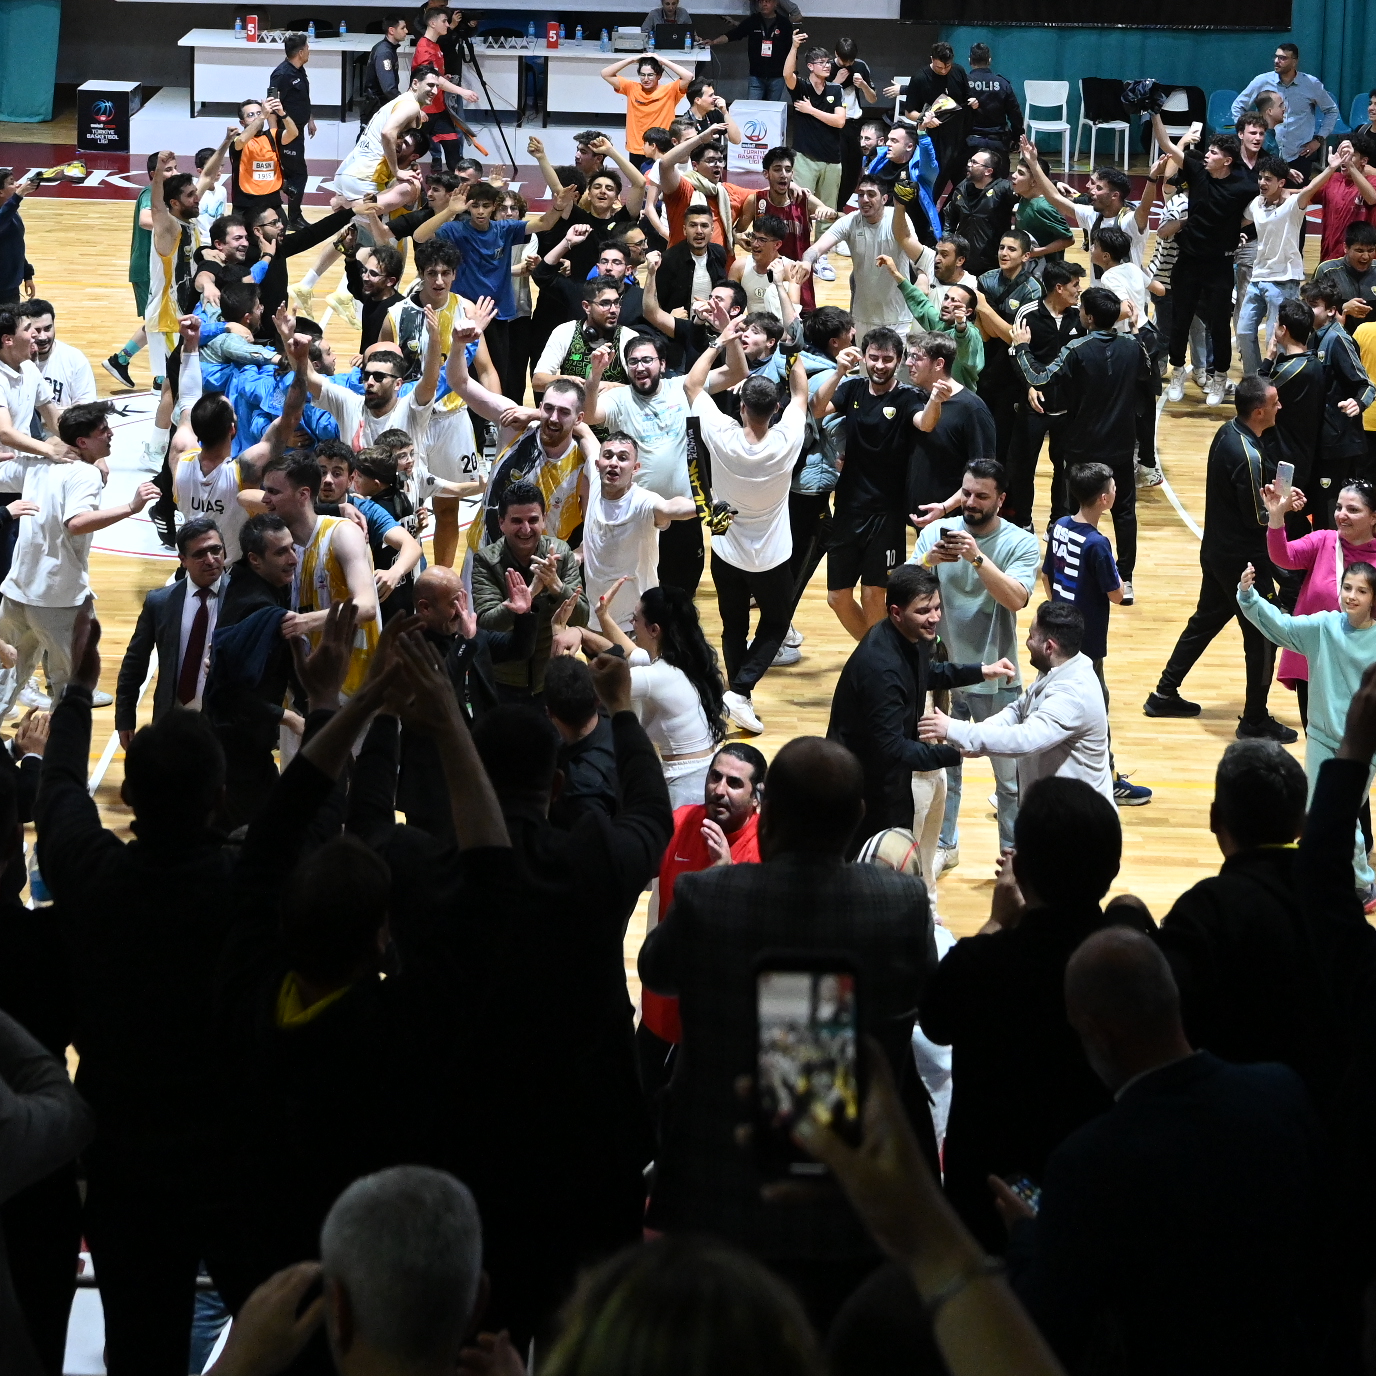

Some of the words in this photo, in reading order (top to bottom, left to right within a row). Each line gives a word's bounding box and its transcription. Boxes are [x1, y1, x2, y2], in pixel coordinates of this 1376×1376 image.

[247, 23, 255, 35] 5
[548, 30, 557, 42] 5
[461, 452, 480, 474] 20
[885, 549, 896, 567] 10
